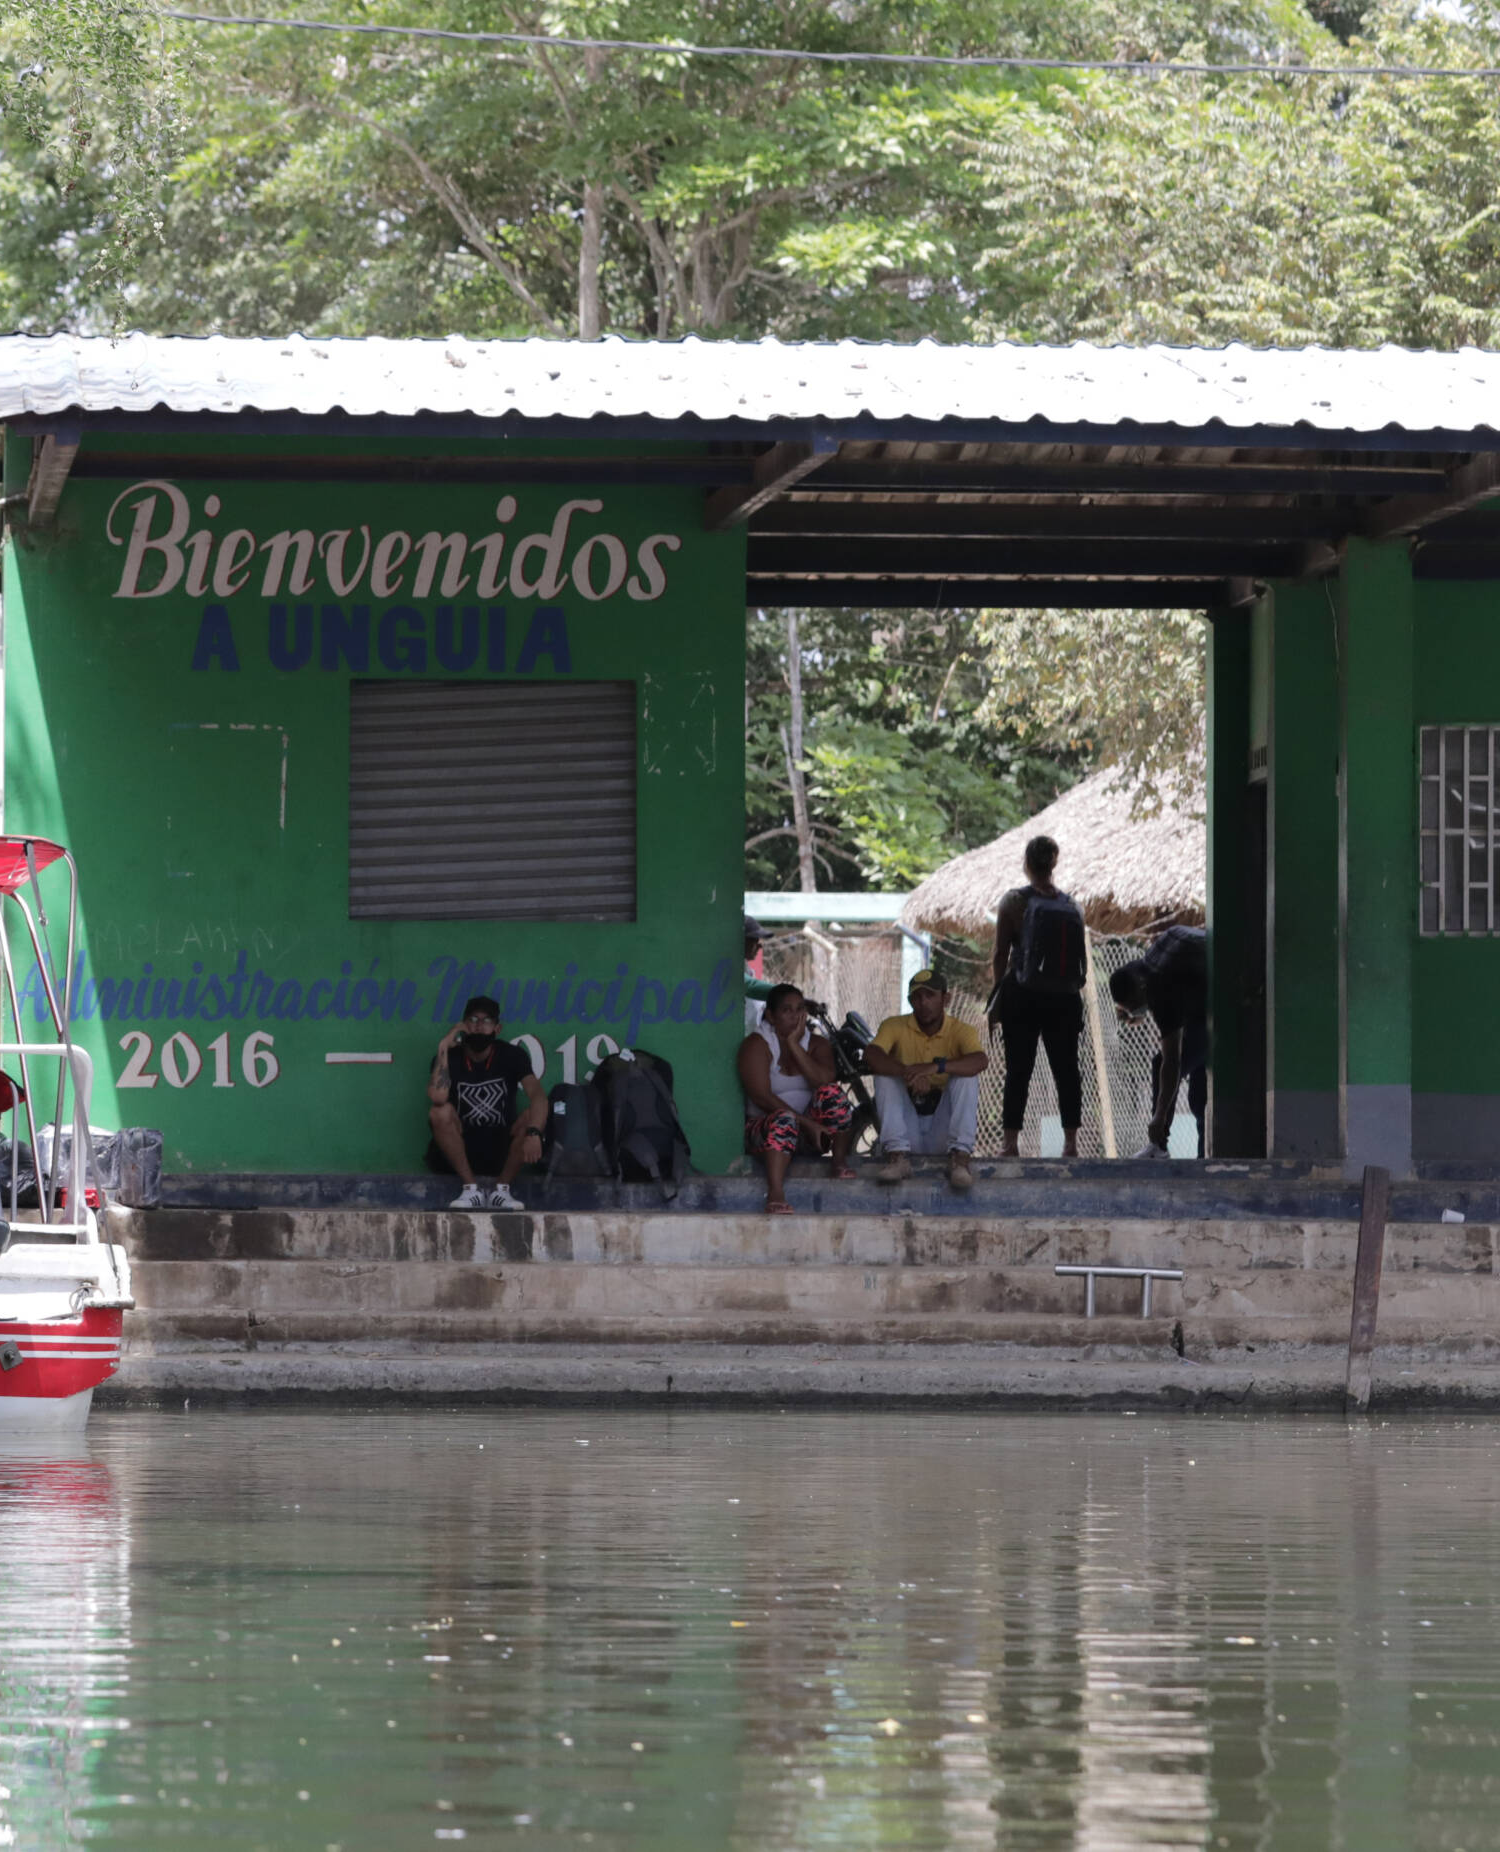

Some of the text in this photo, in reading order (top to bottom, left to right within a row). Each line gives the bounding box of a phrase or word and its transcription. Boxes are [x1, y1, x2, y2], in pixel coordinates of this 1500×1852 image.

[106, 479, 683, 601] Bienvenidos
[191, 604, 573, 674] A UNGUIA
[12, 949, 737, 1046] Administración Municipal
[115, 1031, 280, 1088] 2016
[509, 1033, 621, 1090] 019
